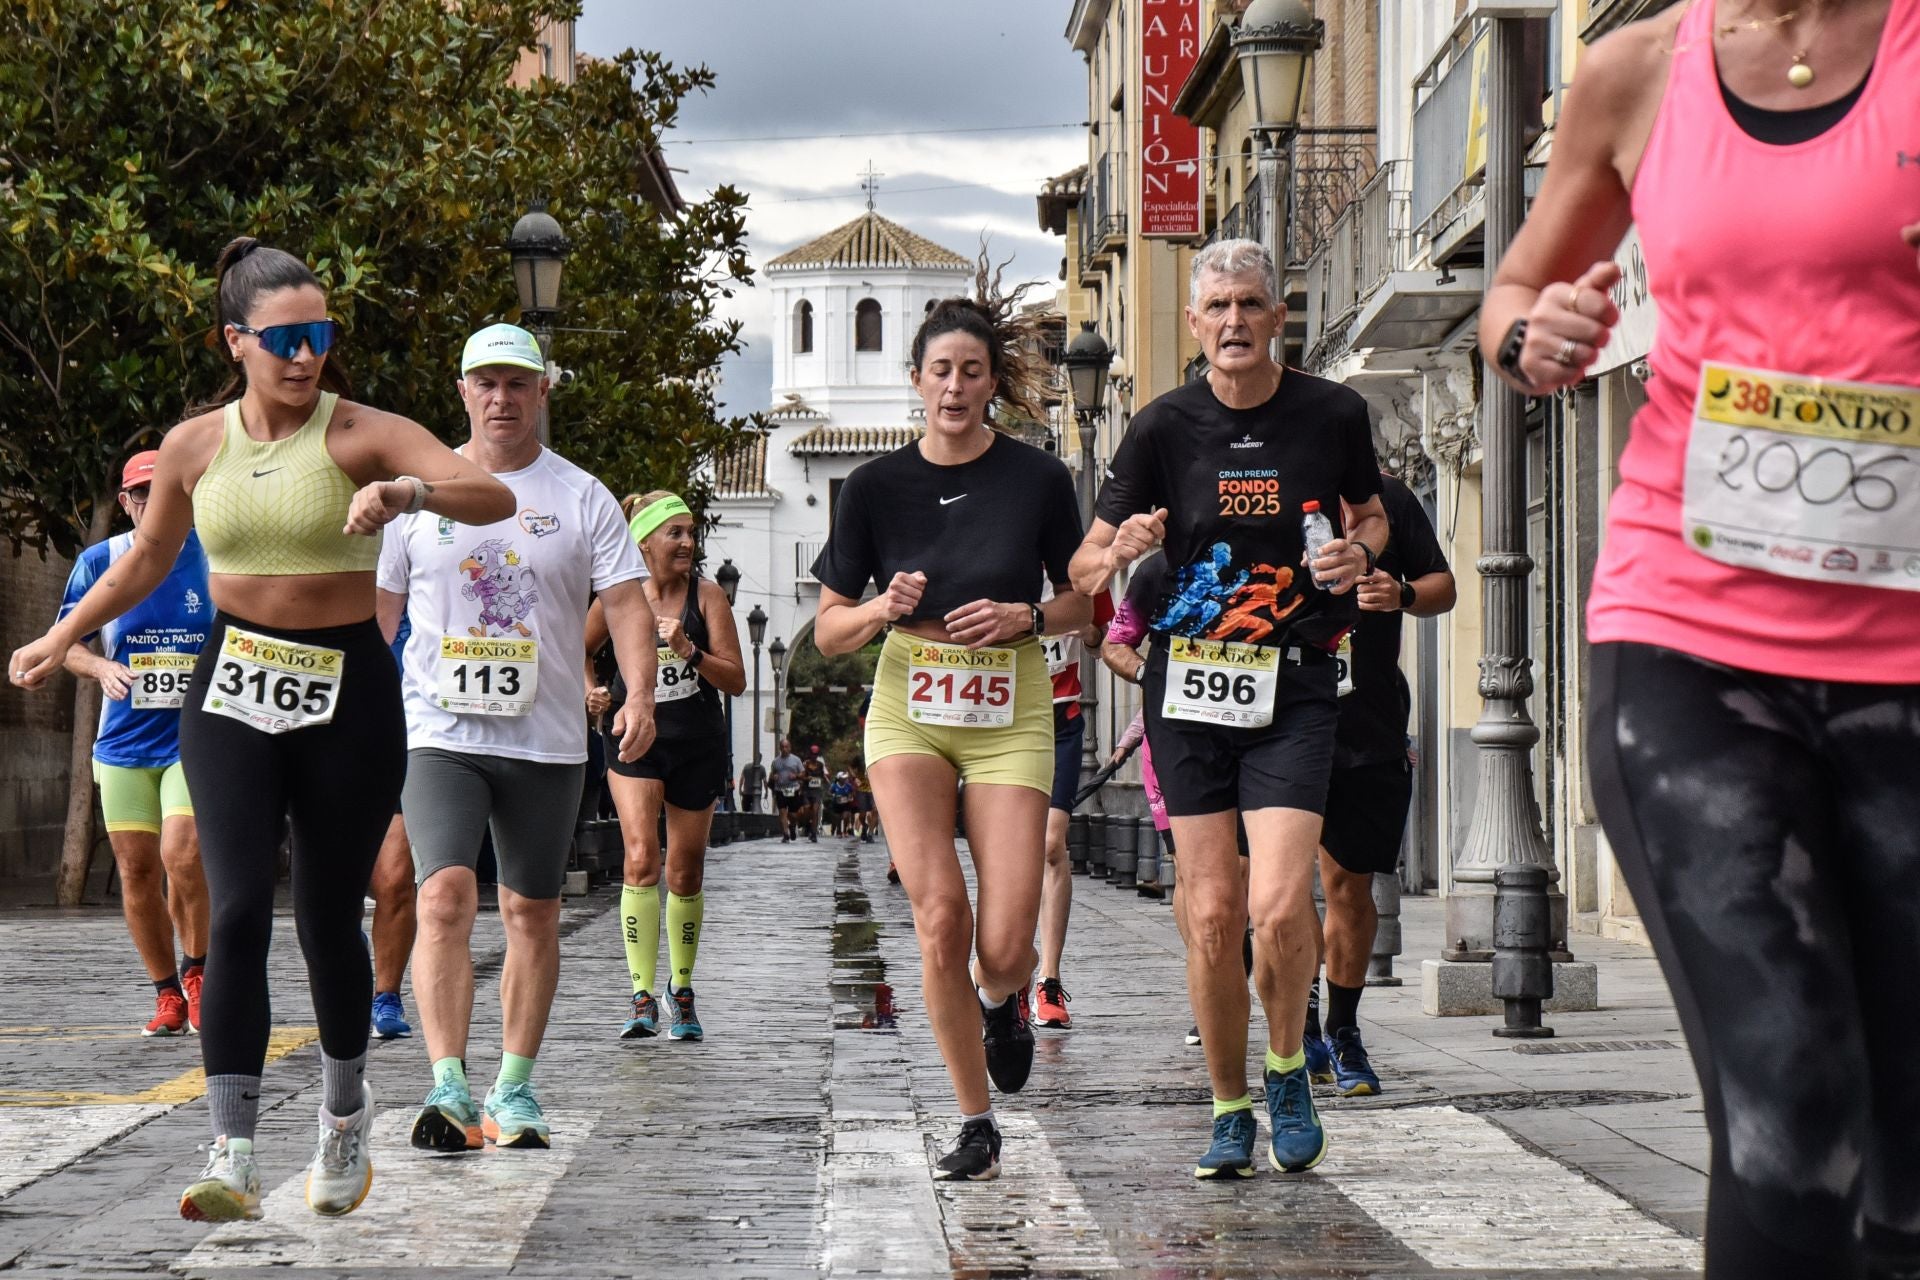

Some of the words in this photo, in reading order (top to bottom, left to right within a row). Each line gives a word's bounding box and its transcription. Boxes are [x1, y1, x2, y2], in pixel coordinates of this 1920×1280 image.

[1144, 0, 1169, 37] A
[1179, 0, 1194, 58] AR
[1144, 55, 1170, 194] UNIÓN
[1144, 201, 1199, 213] Especialidad
[1148, 214, 1160, 222] en
[1162, 212, 1194, 222] comida
[1151, 222, 1192, 232] mexicana
[487, 340, 514, 348] KIPRUN
[1733, 379, 1772, 415] 38
[1773, 395, 1911, 434] FONDO
[1229, 441, 1264, 449] TEAMERGY
[1218, 470, 1243, 478] GRAN
[1244, 469, 1278, 478] PREMIO
[1717, 434, 1910, 512] 2006
[1218, 479, 1279, 494] FONDO
[1218, 494, 1280, 516] 2025
[126, 635, 159, 644] PAZITO
[162, 636, 170, 644] a
[172, 633, 205, 643] PAZITO
[238, 637, 254, 654] 38
[155, 645, 176, 653] Motril
[452, 641, 465, 654] 38
[465, 646, 517, 657] FONDO
[923, 648, 940, 661] 38
[140, 656, 153, 666] 38
[253, 646, 315, 669] FONDO
[656, 652, 680, 661] NDO
[940, 653, 993, 666] FONDO
[143, 672, 193, 694] 895
[453, 664, 520, 696] 113
[661, 664, 697, 686] 84
[217, 661, 332, 716] 3165
[911, 671, 1010, 707] 2145
[1182, 668, 1257, 706] 596
